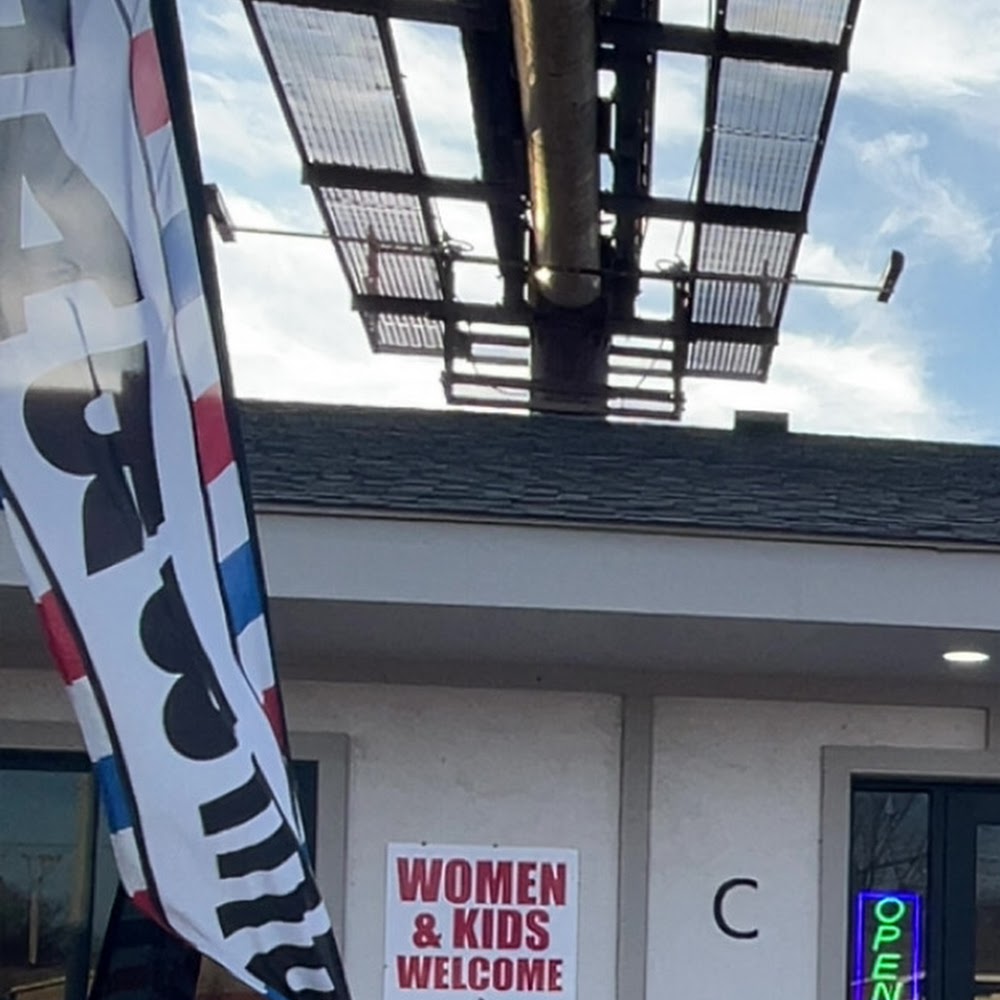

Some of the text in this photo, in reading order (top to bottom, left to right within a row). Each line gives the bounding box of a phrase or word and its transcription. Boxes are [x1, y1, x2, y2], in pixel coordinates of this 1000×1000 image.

[396, 856, 568, 907] WOMEN
[411, 907, 551, 952] & KIDS
[713, 877, 759, 940] C
[396, 955, 564, 992] WELCOME
